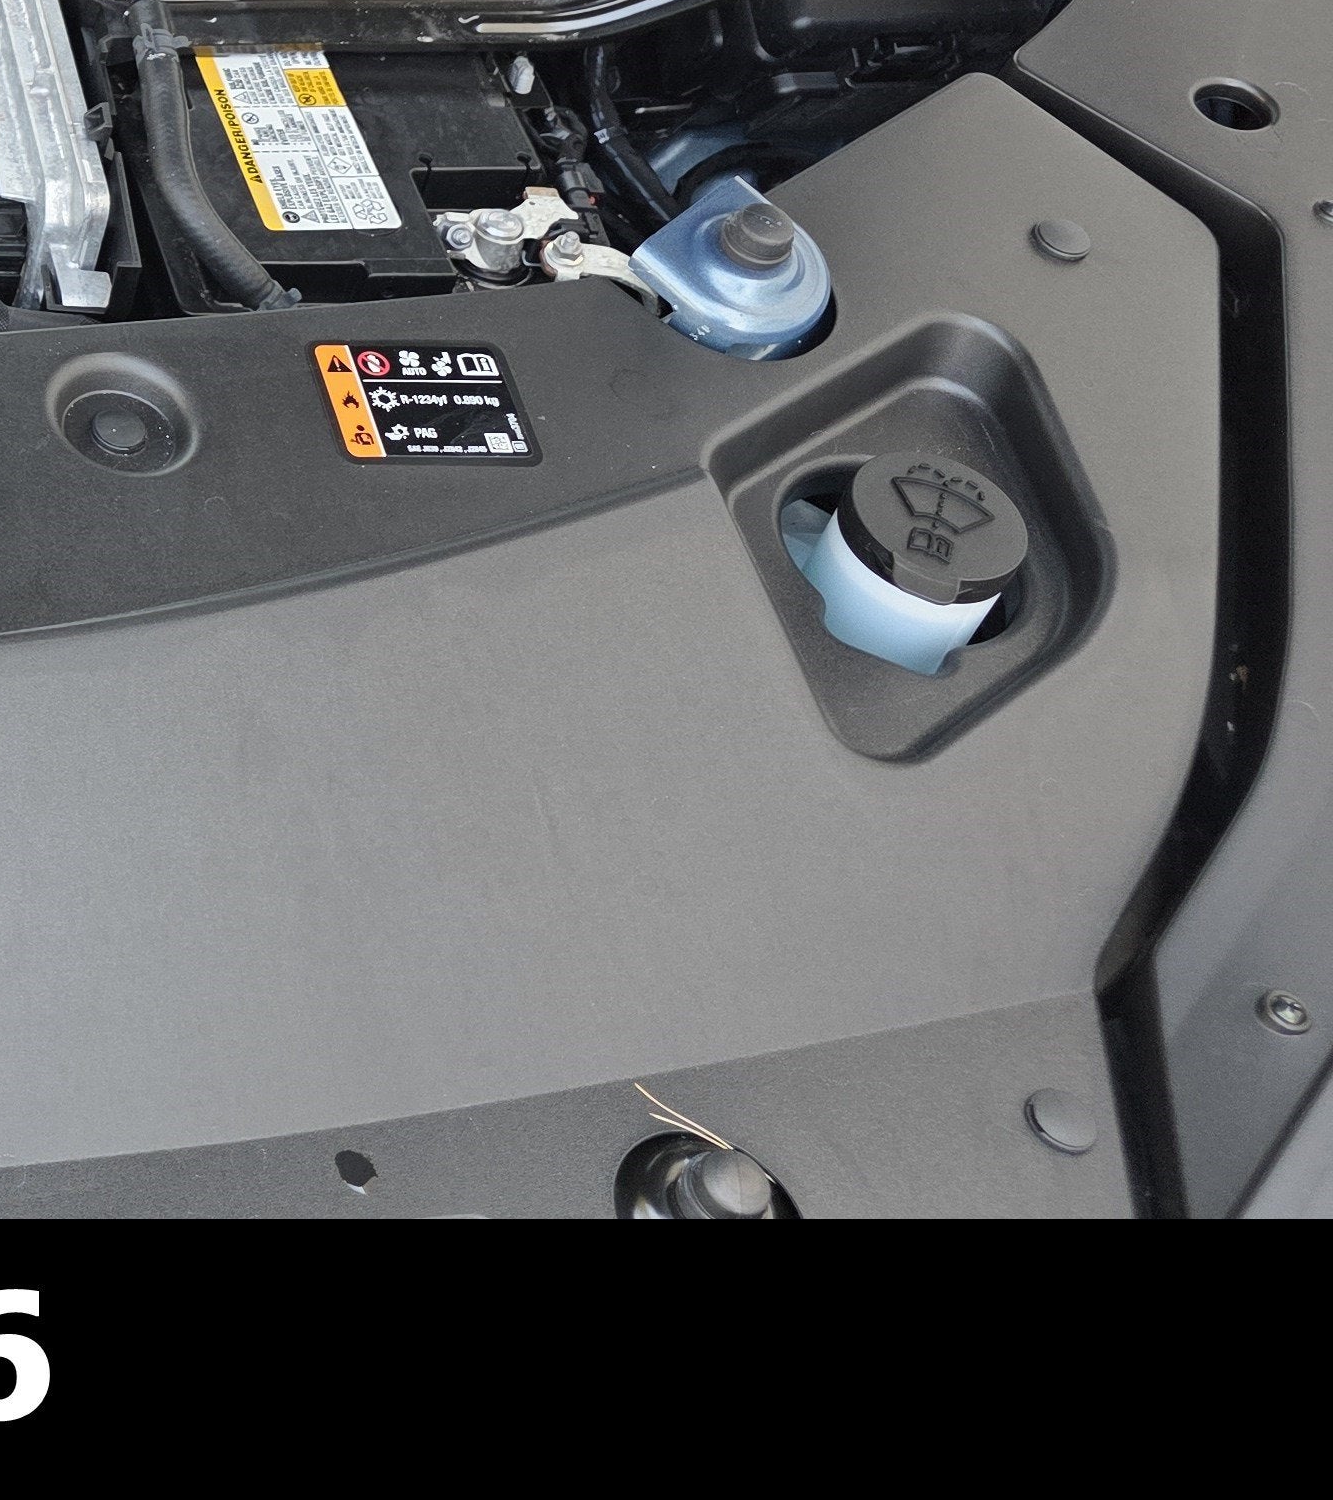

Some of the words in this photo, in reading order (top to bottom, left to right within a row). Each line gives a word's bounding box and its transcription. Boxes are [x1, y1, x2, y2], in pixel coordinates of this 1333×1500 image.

[216, 89, 259, 175] DANGER/POISON
[402, 367, 427, 376] AUTO
[400, 395, 448, 406] R-1234yf
[485, 396, 500, 407] kg
[414, 427, 438, 439] PAG
